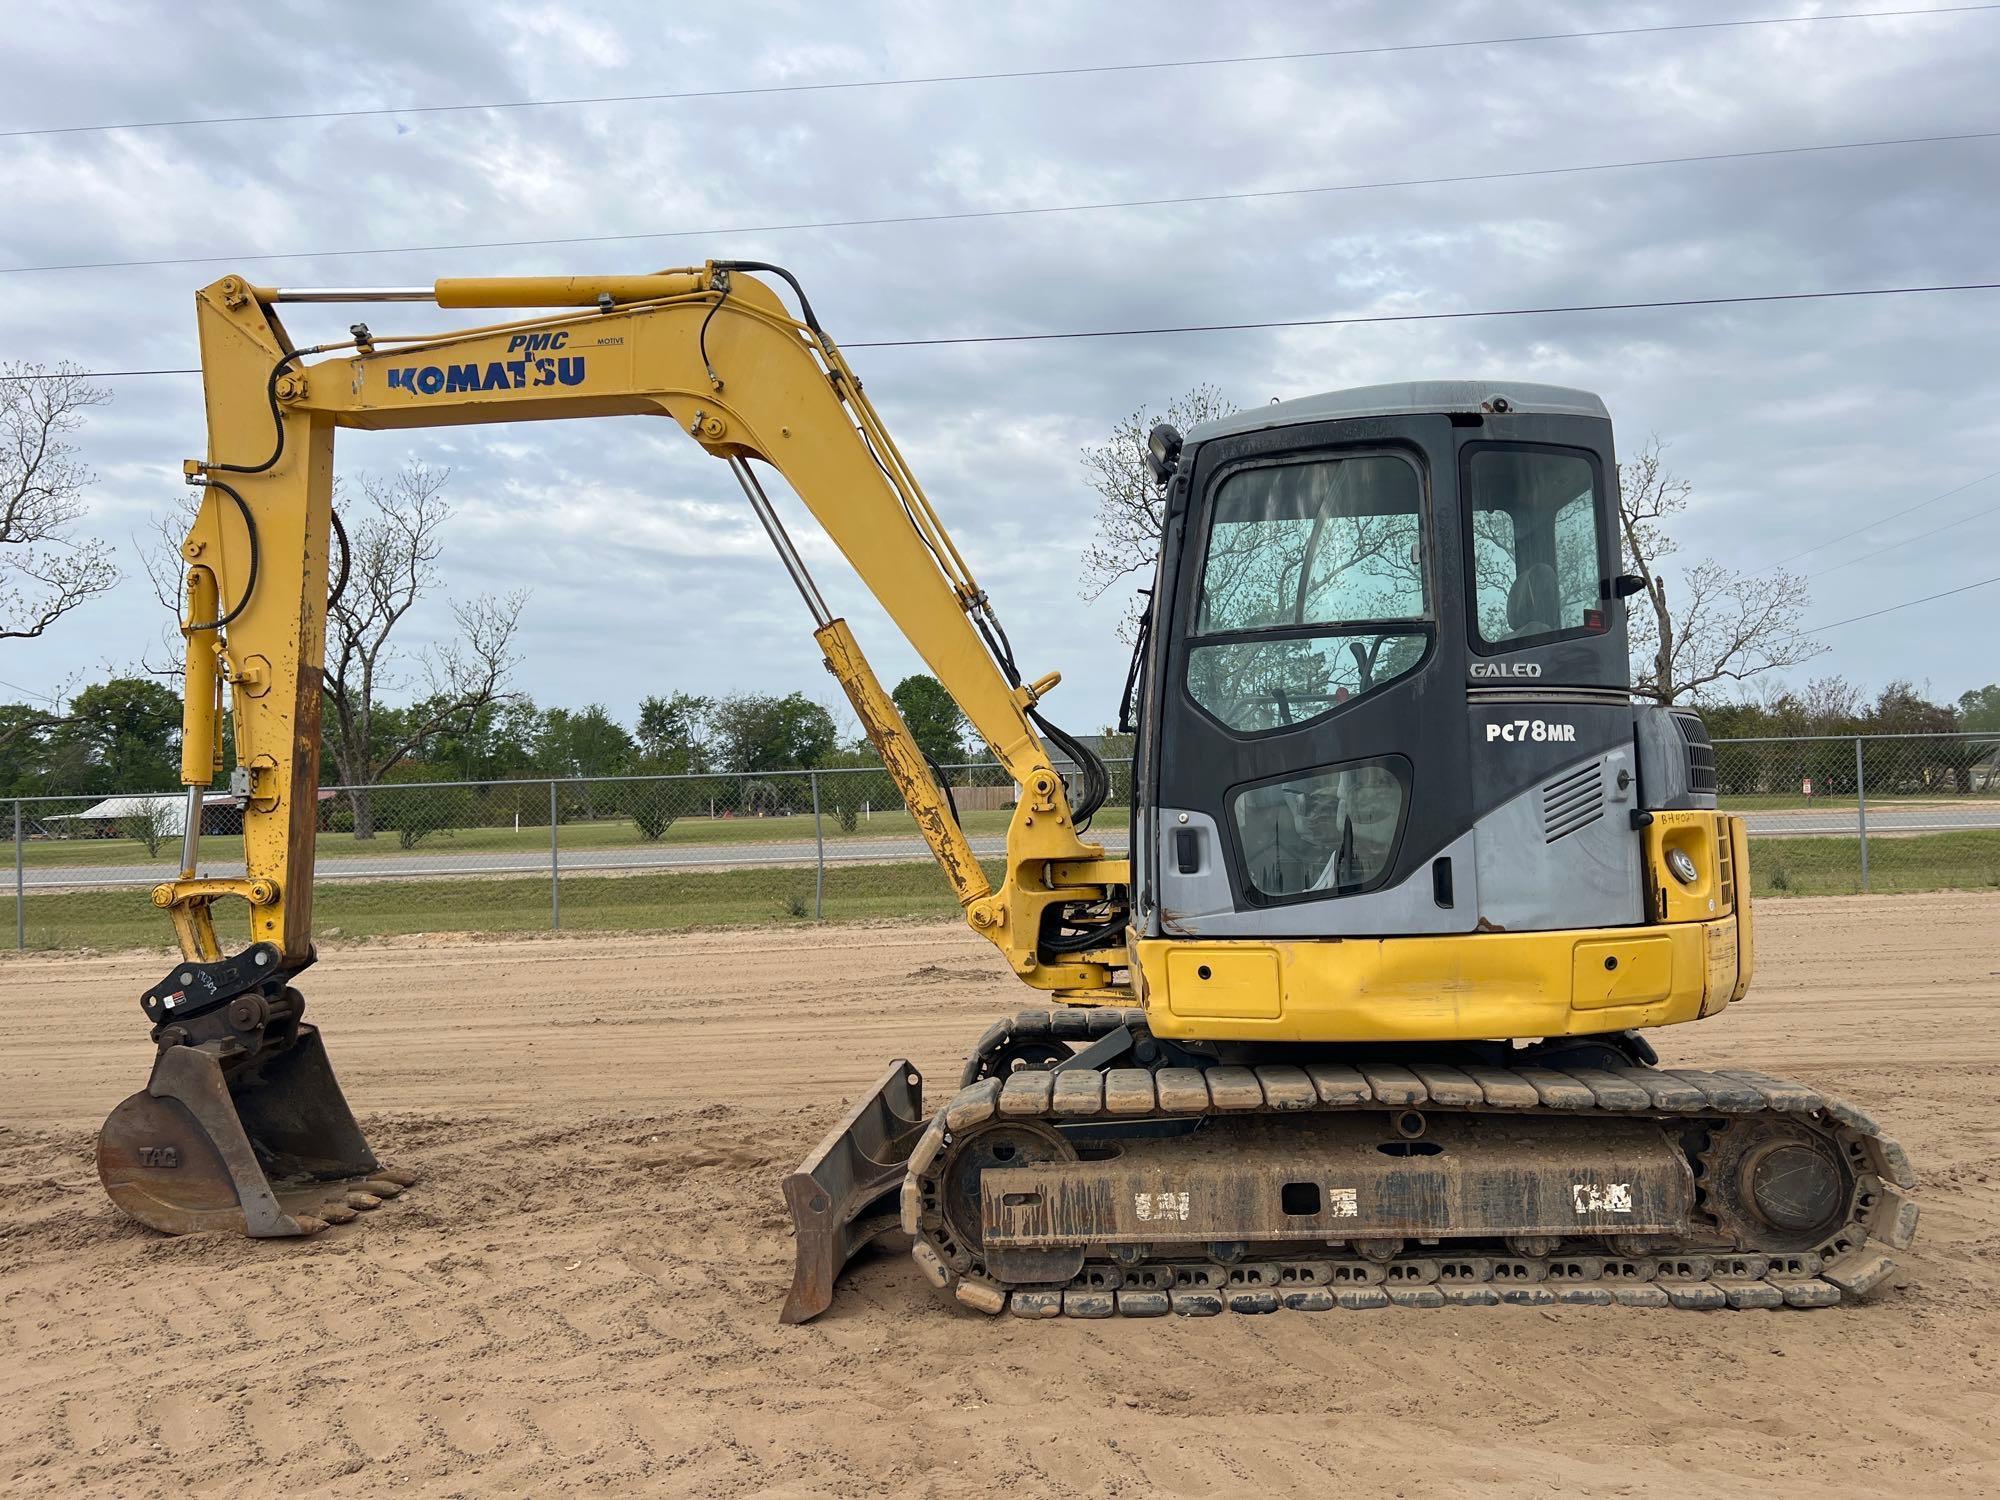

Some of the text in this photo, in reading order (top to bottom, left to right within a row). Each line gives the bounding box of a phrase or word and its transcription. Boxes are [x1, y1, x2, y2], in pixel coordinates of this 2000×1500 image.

[507, 331, 569, 353] PMC
[597, 337, 624, 345] MOTIVE
[388, 352, 585, 395] KOMATSU
[1469, 663, 1542, 678] GALEO
[1486, 720, 1576, 742] PC78MR
